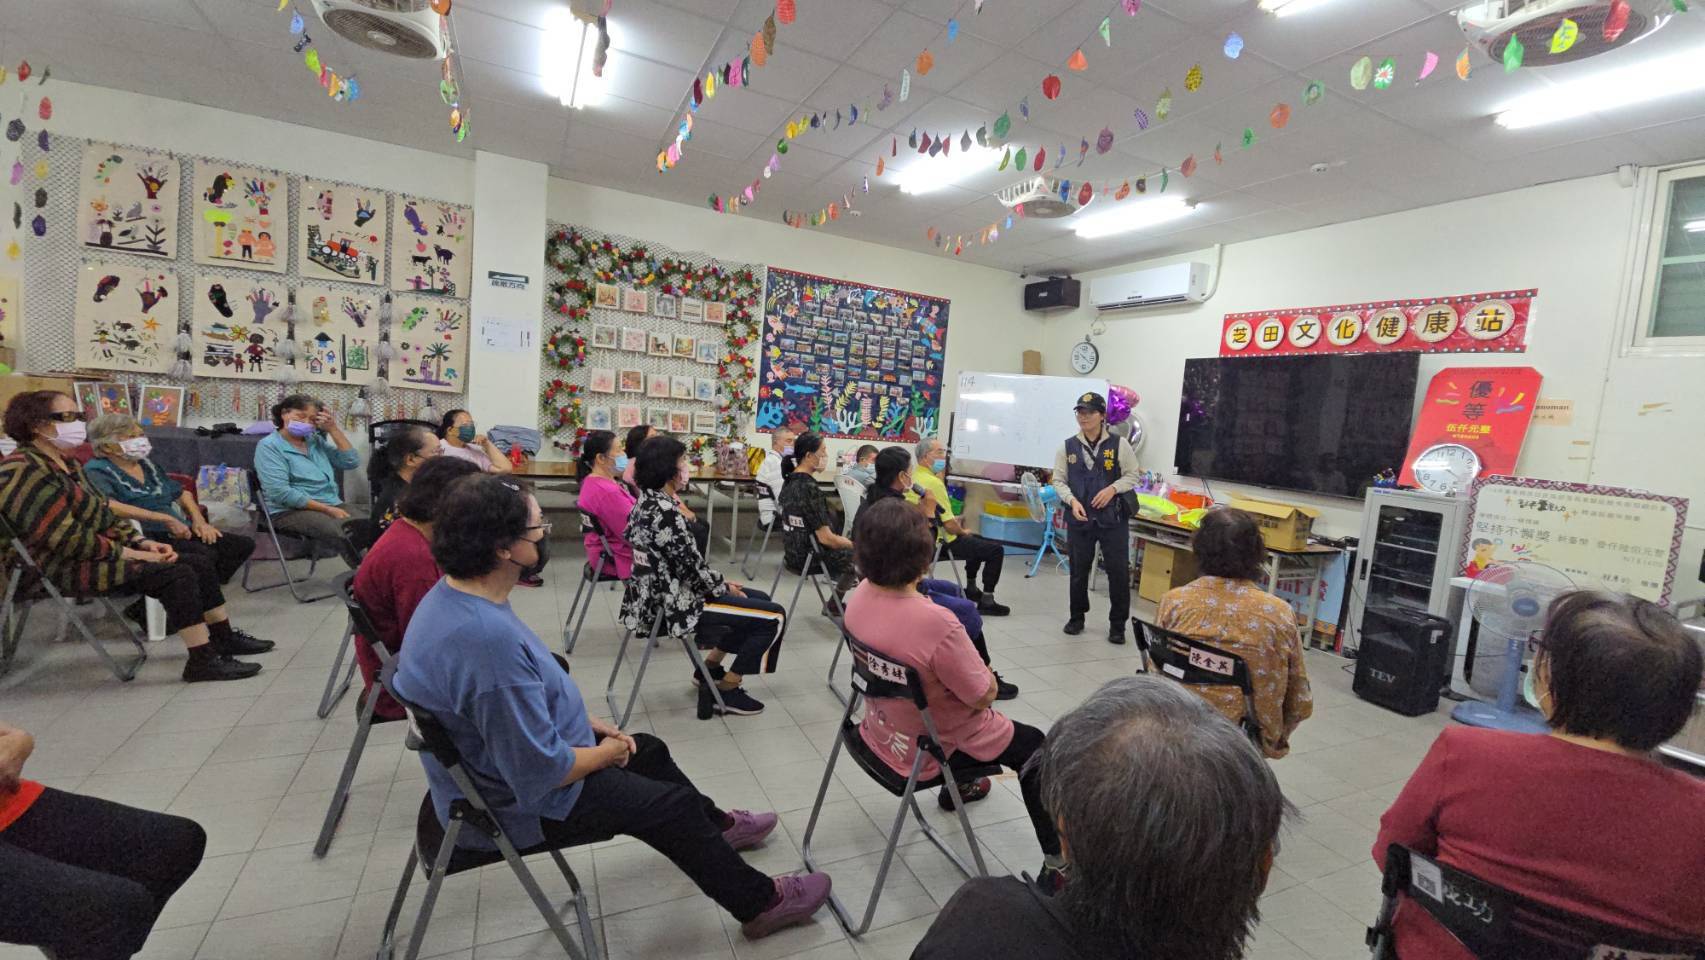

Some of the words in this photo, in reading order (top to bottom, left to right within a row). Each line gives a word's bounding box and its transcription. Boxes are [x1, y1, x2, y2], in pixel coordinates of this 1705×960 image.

[1231, 308, 1506, 344] 芝田文化健康站
[1462, 380, 1494, 420] 優等
[1446, 448, 1456, 456] 12
